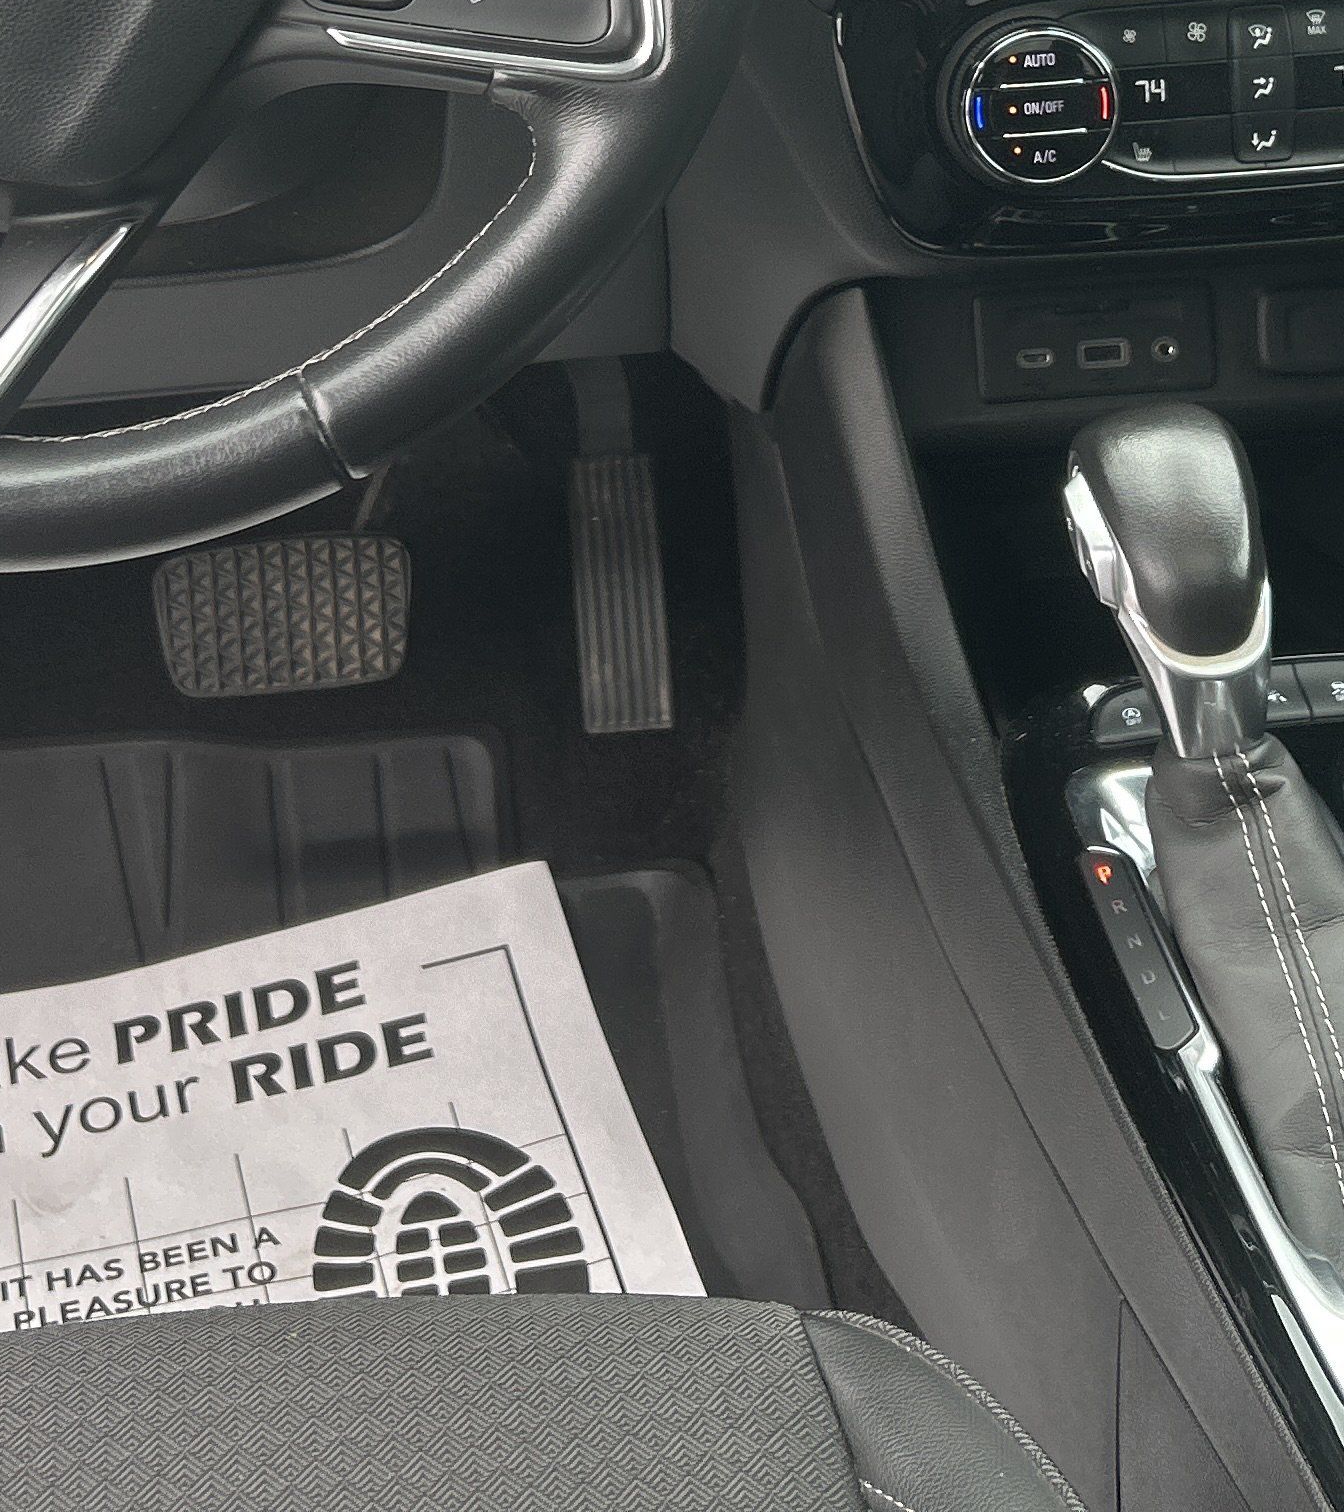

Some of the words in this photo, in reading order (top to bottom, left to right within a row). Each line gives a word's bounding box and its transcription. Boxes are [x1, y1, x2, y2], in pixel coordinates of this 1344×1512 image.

[1307, 25, 1327, 36] MAX
[1023, 52, 1056, 69] AUTO
[1134, 78, 1166, 103] 74
[1023, 100, 1065, 116] ON/OFF
[1033, 149, 1057, 165] A/C
[1094, 864, 1112, 886] P
[1111, 899, 1128, 915] R
[113, 959, 367, 1065] PRIDE
[32, 1075, 200, 1158] your
[230, 1012, 435, 1104] RIDE
[0, 1275, 32, 1301] IT
[45, 1258, 125, 1291] HAS
[139, 1232, 241, 1273] BEEN
[254, 1226, 282, 1249] A
[13, 1272, 213, 1330] PLEASURE
[222, 1260, 278, 1289] TO
